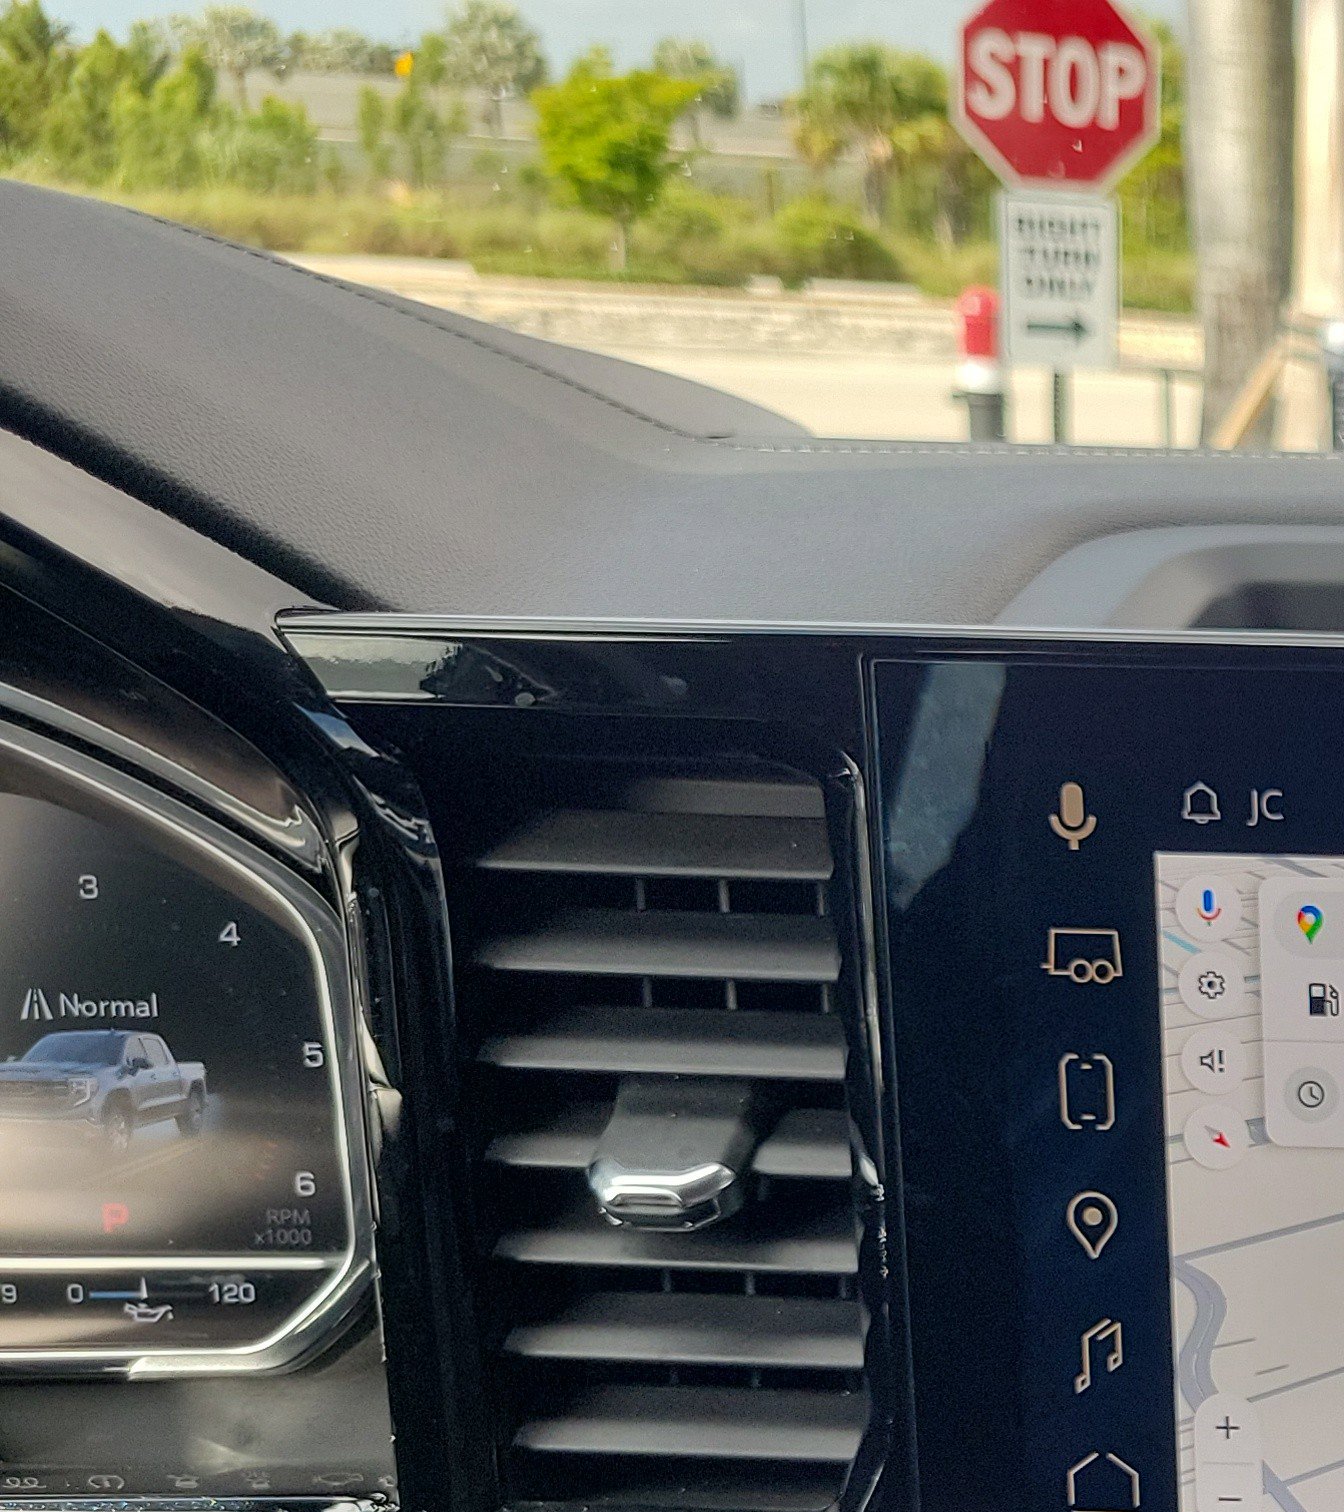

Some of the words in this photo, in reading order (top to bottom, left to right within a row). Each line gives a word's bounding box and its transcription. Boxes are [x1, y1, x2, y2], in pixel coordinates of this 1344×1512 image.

[966, 27, 1148, 130] STOP
[1246, 788, 1284, 827] JC
[78, 874, 99, 900] 3
[218, 920, 242, 947] 4
[59, 991, 159, 1018] Normal
[302, 1040, 325, 1069] 5
[294, 1171, 317, 1197] 6
[102, 1202, 130, 1234] P
[265, 1207, 312, 1226] RPM
[253, 1228, 313, 1246] x1000
[66, 1283, 85, 1304] 0
[207, 1282, 257, 1304] 120
